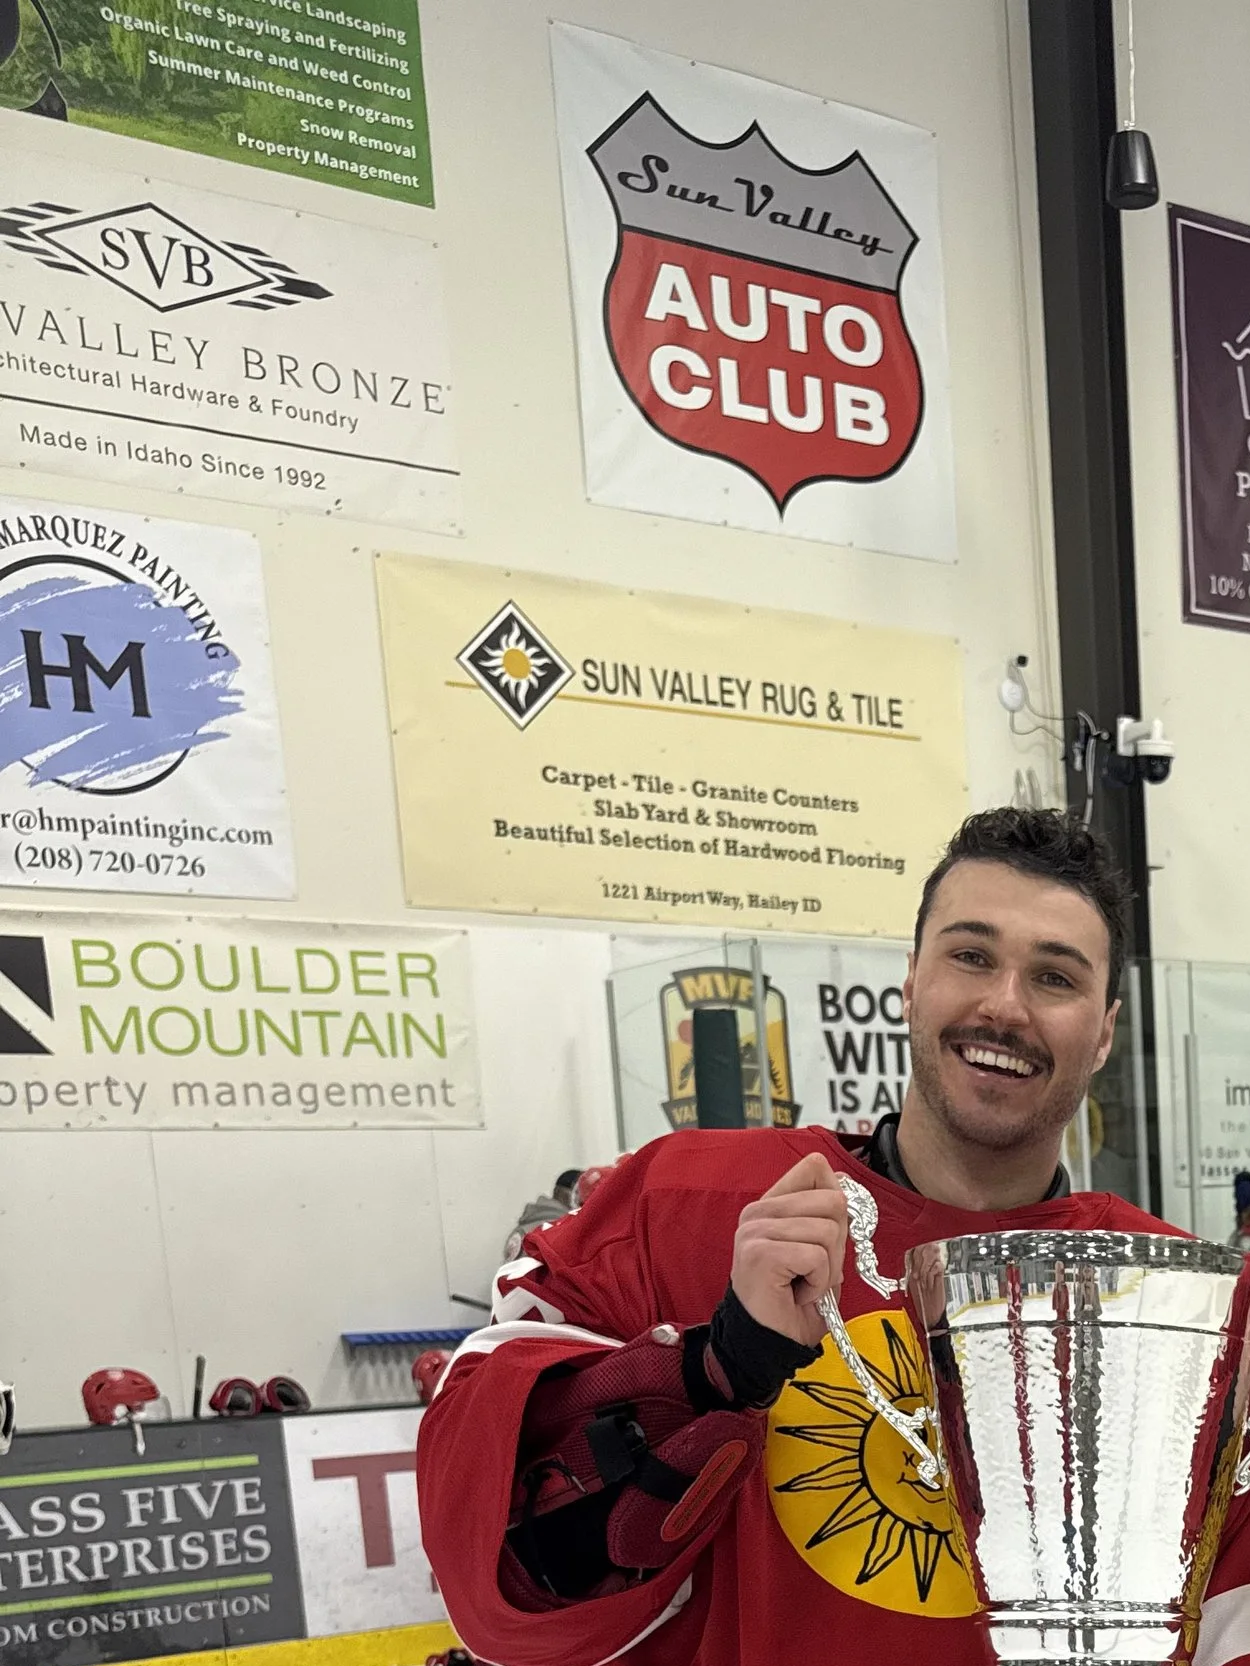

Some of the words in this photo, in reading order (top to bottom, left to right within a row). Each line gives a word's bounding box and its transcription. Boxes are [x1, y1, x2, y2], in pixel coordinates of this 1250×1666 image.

[100, 6, 170, 38] Organic
[175, 24, 221, 51] Lawn
[225, 39, 264, 62] Care
[268, 52, 299, 72] and
[303, 60, 349, 85] Weed
[352, 74, 411, 101] Control
[217, 8, 290, 42] Spraying
[295, 28, 325, 49] and
[329, 37, 410, 75] Fertilizing
[306, 3, 407, 46] Landscaping
[148, 49, 220, 81] Summer
[225, 69, 334, 110] Maintenance
[338, 98, 415, 131] Programs
[237, 132, 310, 166] Property
[314, 150, 420, 188] Management
[300, 118, 344, 143] Snow
[348, 130, 417, 160] Removal
[617, 154, 736, 214] Sun
[733, 176, 895, 257] Valley
[100, 226, 214, 289] SVB
[643, 261, 885, 369] AUTO
[0, 301, 211, 371] VALLEY
[242, 345, 447, 416] BRONZE
[132, 374, 240, 411] Hardware
[249, 393, 263, 414] &
[271, 398, 360, 435] Foundry
[648, 344, 892, 447] CLUB
[20, 423, 88, 452] Made
[97, 435, 118, 457] in
[127, 440, 193, 470] Idaho
[201, 454, 265, 482] Since
[273, 466, 328, 492] 1992
[0, 514, 126, 558] MARQUEZ
[128, 541, 230, 661] PAINTING
[1208, 574, 1246, 600] 10%
[20, 628, 153, 718] HM
[581, 657, 642, 699] SUN
[649, 666, 752, 712] VALLEY
[762, 680, 817, 721] RUG
[826, 691, 845, 722] &
[851, 692, 905, 730] TILE
[541, 764, 617, 793] Carpet
[632, 774, 674, 796] Tile
[692, 779, 768, 806] Granite
[772, 788, 860, 814] Counters
[593, 799, 640, 821] Slab
[641, 802, 692, 827] Yard
[695, 808, 711, 827] &
[716, 810, 818, 837] Showroom
[13, 840, 84, 877] (208)
[89, 848, 206, 878] 720-0726
[493, 818, 594, 846] Beautiful
[600, 828, 695, 855] Selection
[700, 837, 722, 857] of
[724, 838, 822, 866] Hardwood
[825, 848, 907, 876] Flooring
[601, 882, 639, 900] 1221
[644, 885, 705, 907] Airport
[706, 890, 744, 911] Way,
[747, 893, 799, 915] Hailey
[802, 898, 822, 913] ID
[71, 939, 441, 998] BOULDER
[80, 1004, 448, 1059] MOUNTAIN
[173, 1078, 457, 1114] management
[827, 1080, 861, 1114] IS
[121, 1476, 267, 1530] FIVE
[47, 1593, 272, 1642] CONSTRUCTION
